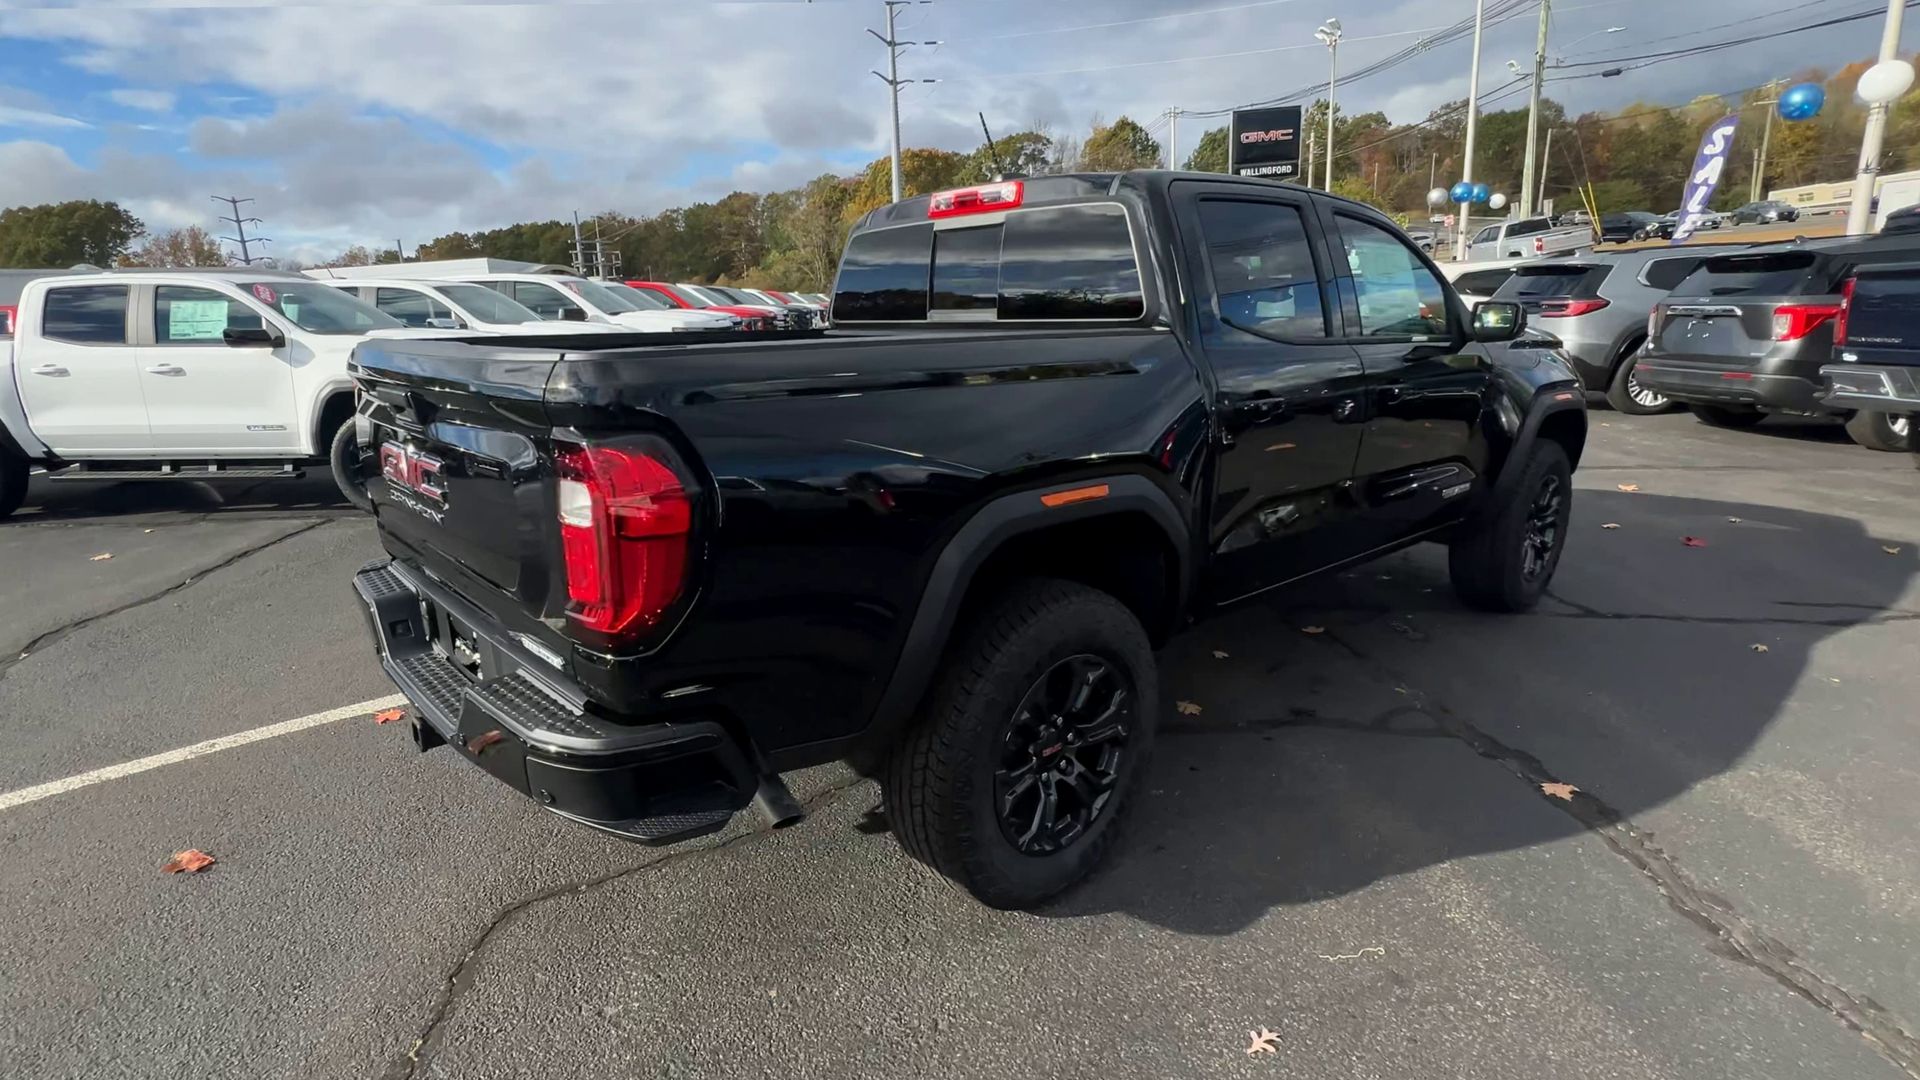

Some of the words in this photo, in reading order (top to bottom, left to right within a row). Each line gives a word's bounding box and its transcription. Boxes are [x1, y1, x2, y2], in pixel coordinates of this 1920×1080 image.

[1240, 129, 1293, 144] GMC
[1240, 165, 1292, 177] WALLINGFORD
[381, 440, 445, 503] GMC
